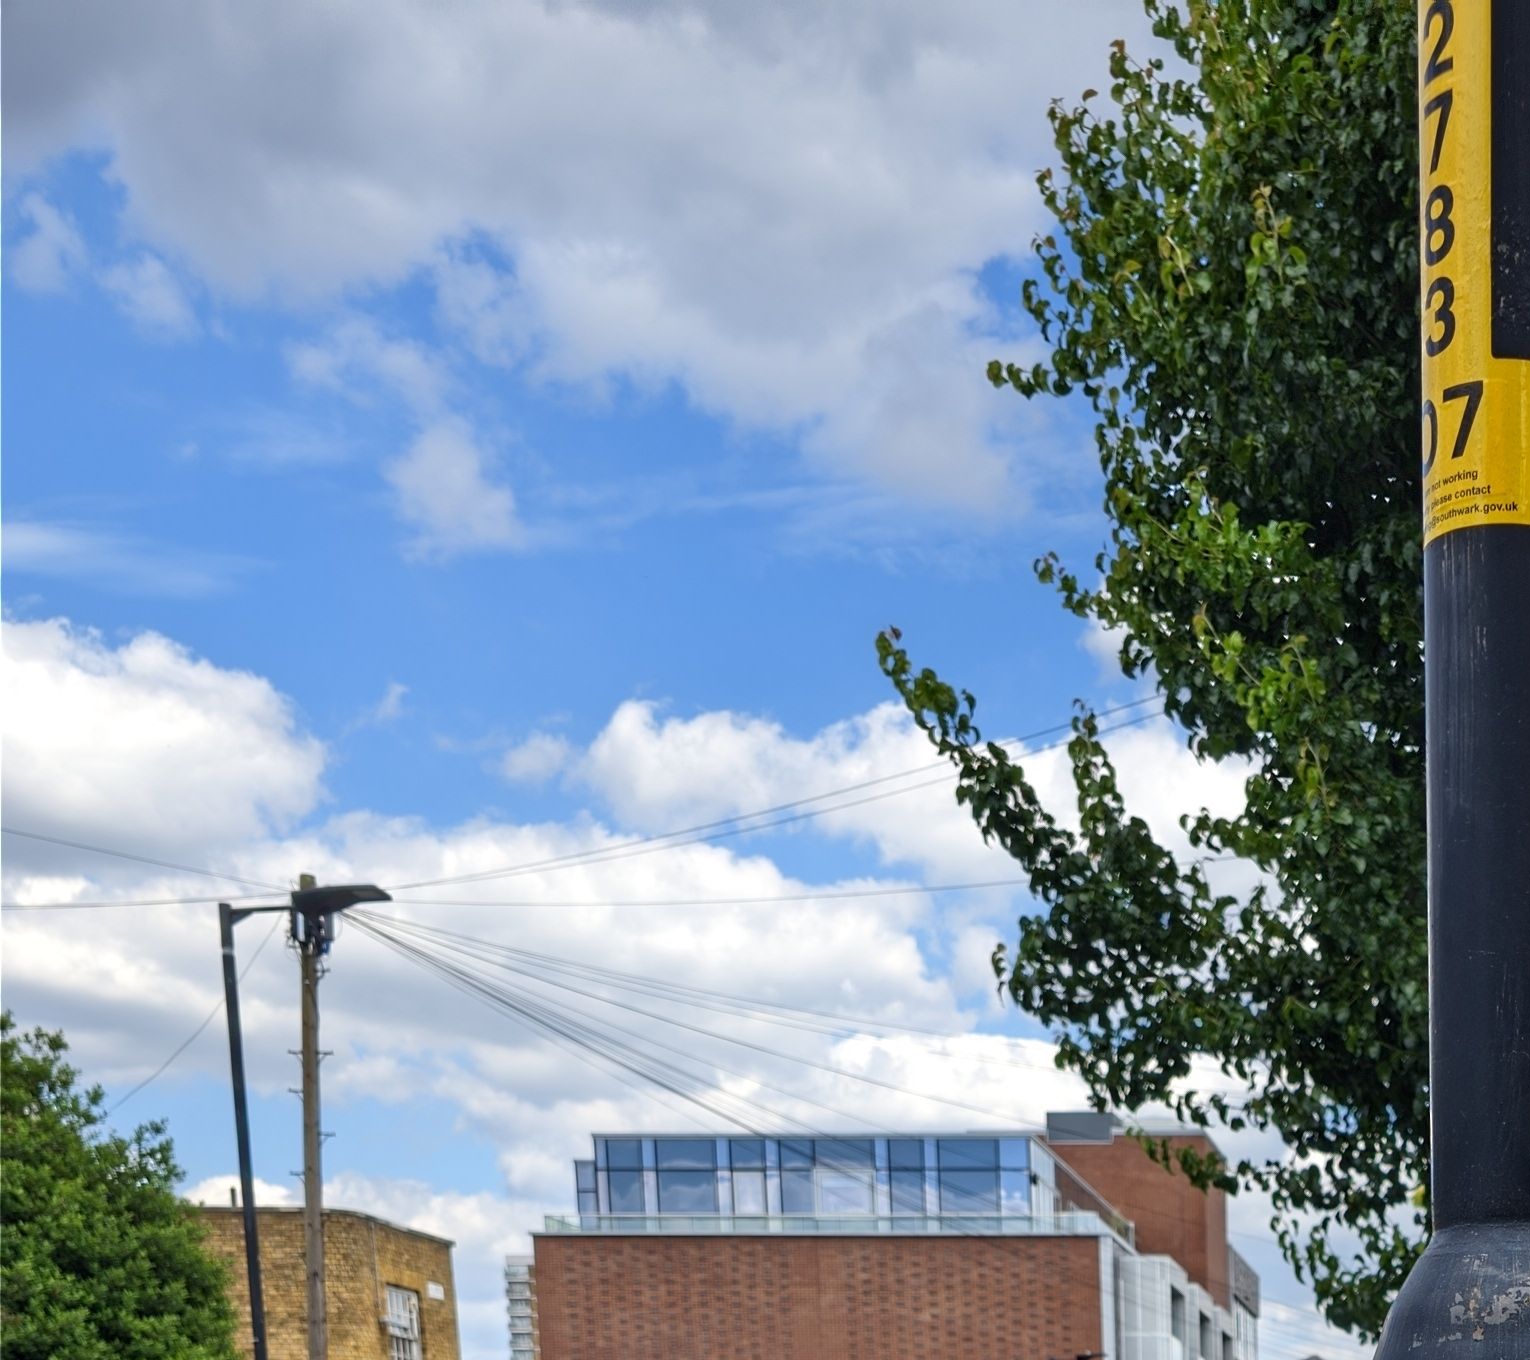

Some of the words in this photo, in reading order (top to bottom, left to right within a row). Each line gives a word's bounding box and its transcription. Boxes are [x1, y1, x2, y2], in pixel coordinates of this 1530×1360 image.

[1443, 470, 1478, 486] working
[1431, 493, 1452, 510] please
[1455, 485, 1491, 498] contact
